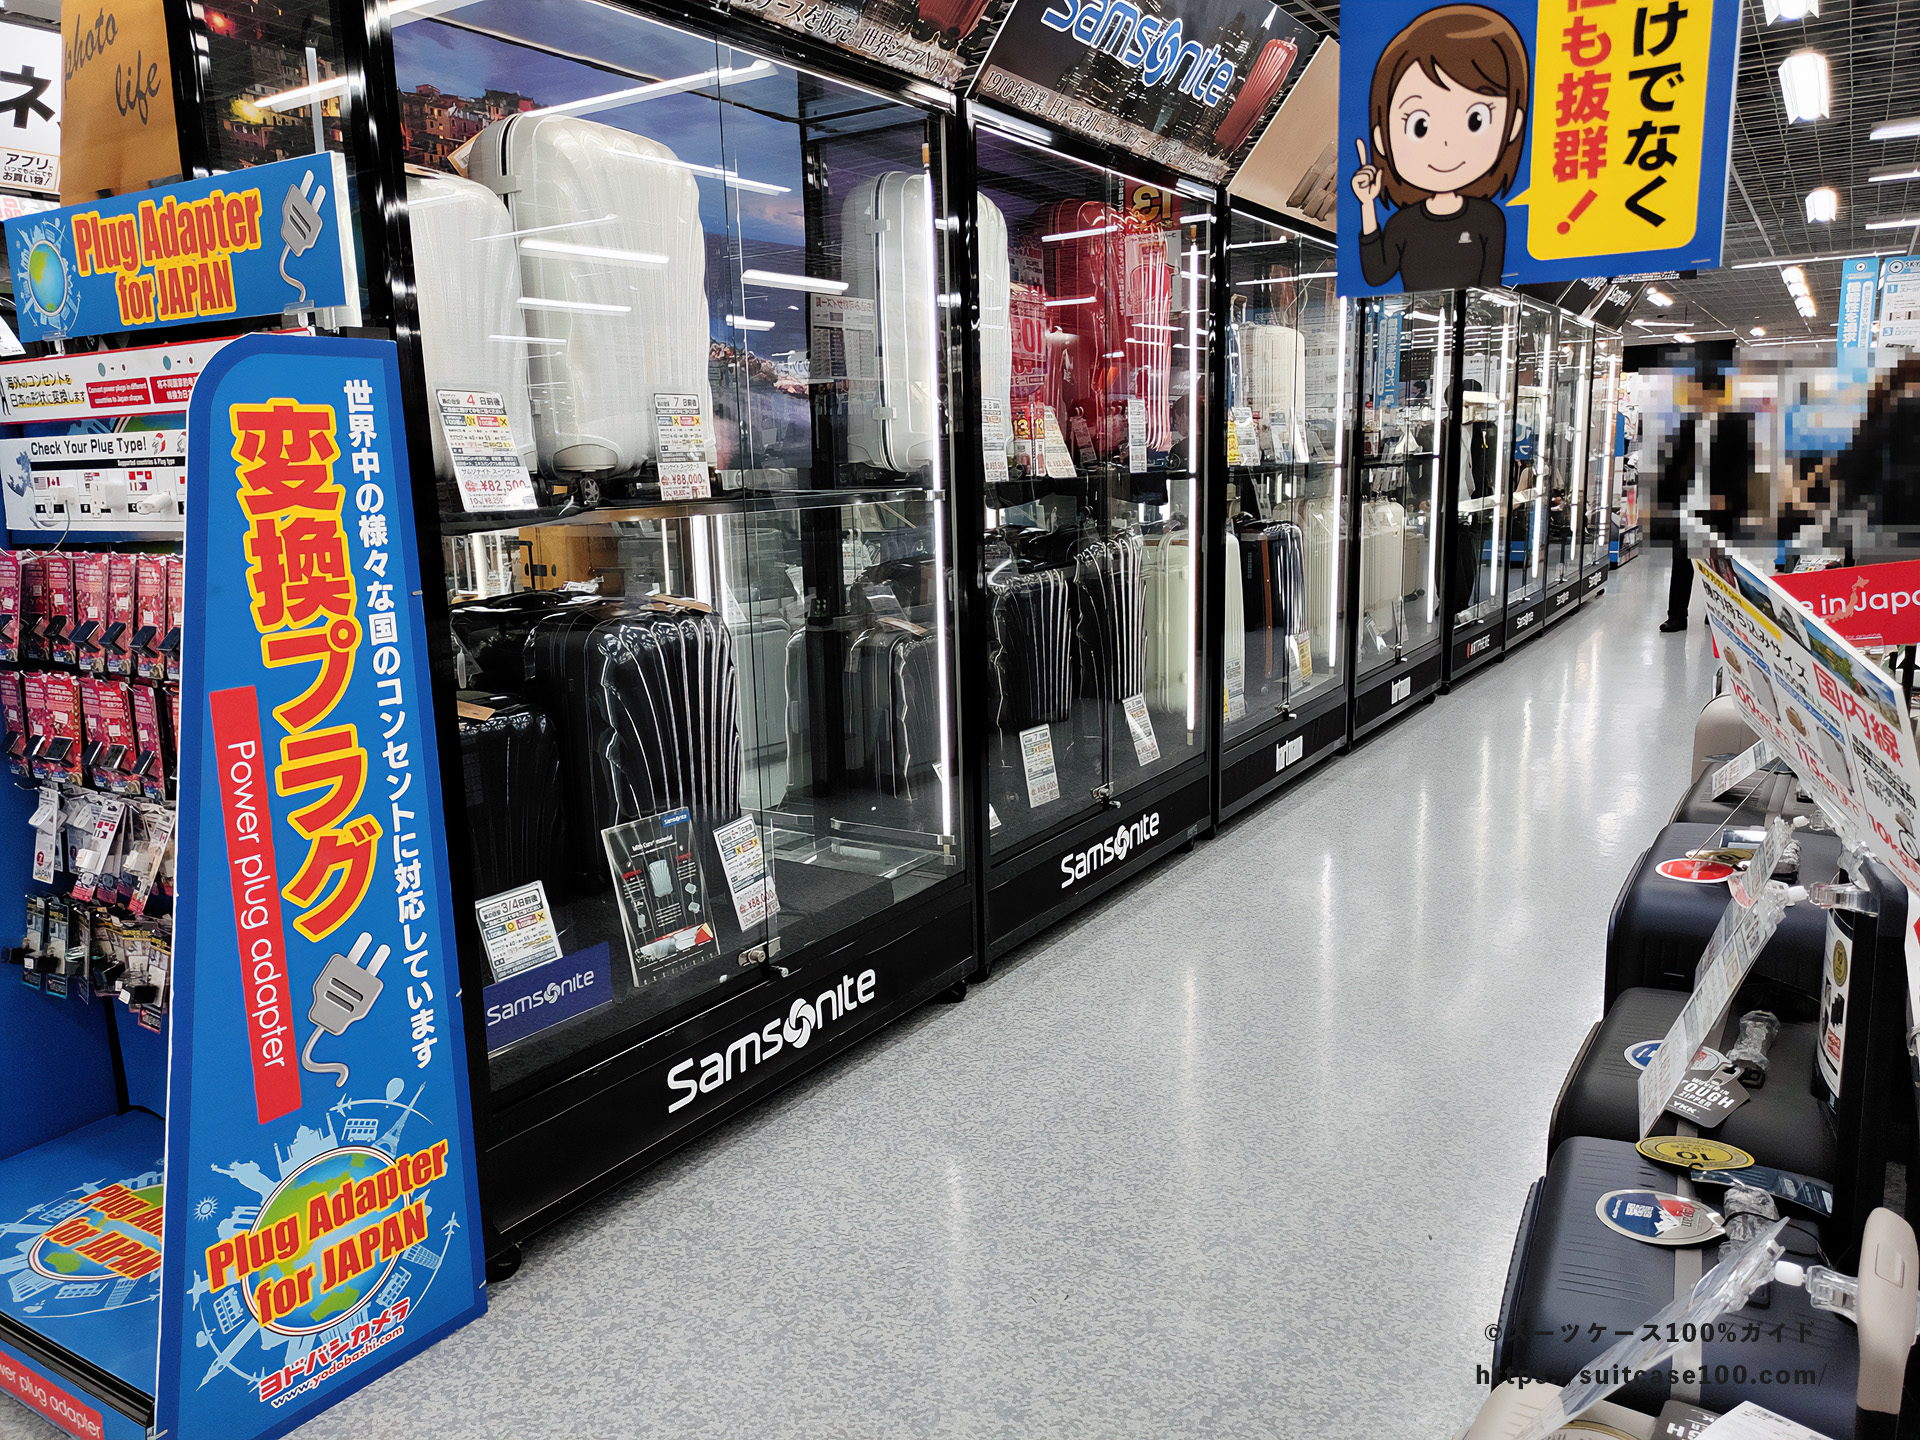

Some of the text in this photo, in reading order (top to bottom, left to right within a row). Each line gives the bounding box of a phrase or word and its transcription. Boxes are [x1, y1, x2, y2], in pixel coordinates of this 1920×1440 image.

[64, 8, 118, 100] photo
[744, 0, 854, 46] ースを販売。
[1041, 0, 1237, 108] Samsonite
[116, 50, 161, 125] life
[1552, 0, 1616, 236] も抜群！
[1622, 0, 1688, 228] けでなく
[72, 188, 261, 277] Plug Adapter
[116, 256, 237, 325] for JAPAN
[466, 394, 475, 405] 4
[31, 436, 147, 456] Check Your Plug Type!
[1820, 594, 1846, 615] in
[230, 398, 383, 943] 変換プラグ
[343, 378, 439, 1068] 世界中の様々な国のコンセントに対応しています
[1812, 661, 1904, 768] 国内線
[1061, 812, 1160, 889] Samsonite
[228, 740, 286, 1070] Power plug adapter
[486, 968, 595, 1027] Samsonite
[667, 968, 876, 1114] Samsonite
[1671, 1100, 1699, 1116] YKK
[1679, 1090, 1711, 1109] ZIPPER
[43, 1216, 91, 1250] for
[80, 1182, 152, 1222] Plug
[206, 1139, 448, 1294] Plug Adapter
[252, 1199, 430, 1329] for JAPAN
[259, 1297, 412, 1405] ヨドバシカメラ
[271, 1325, 405, 1409] www.yodobashi.com
[0, 1363, 101, 1439] wer plug adapter
